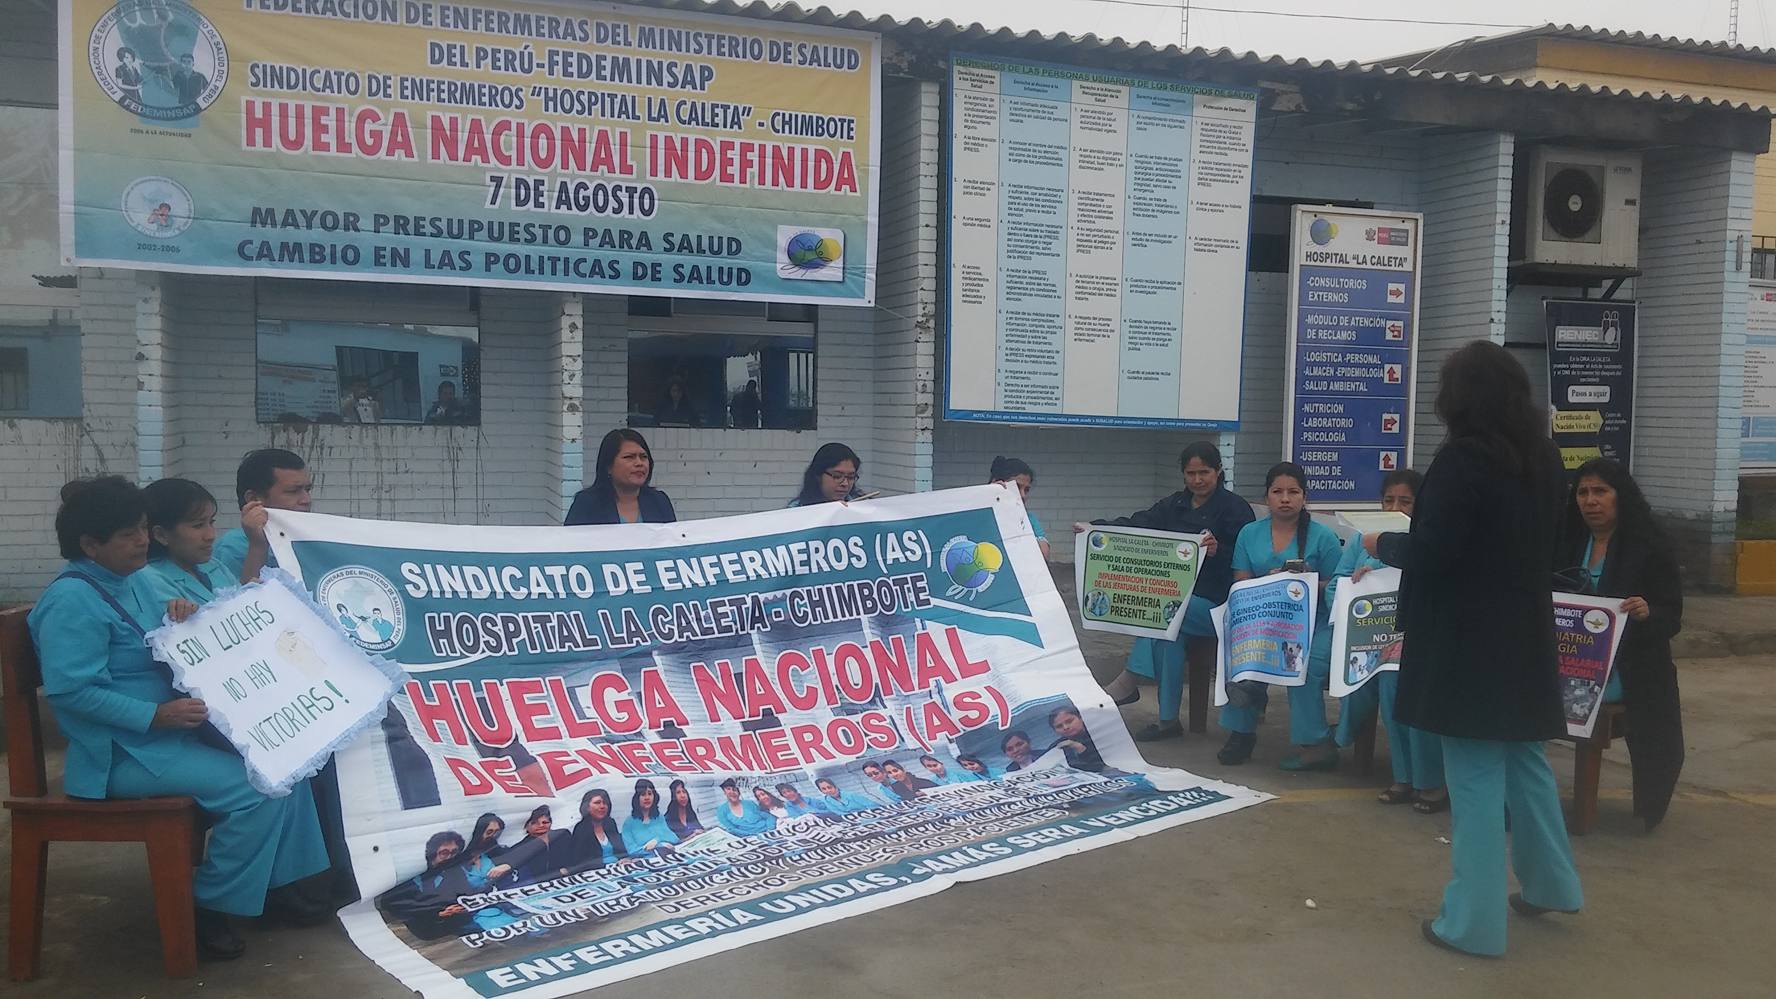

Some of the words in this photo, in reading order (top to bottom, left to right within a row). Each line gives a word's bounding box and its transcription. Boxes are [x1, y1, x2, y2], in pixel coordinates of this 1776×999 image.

[406, 4, 433, 26] DE
[440, 6, 589, 42] ENFERMERAS
[596, 21, 632, 47] DEL
[638, 25, 762, 60] MINISTERIO
[768, 40, 792, 63] DE
[798, 43, 860, 70] SALUD
[430, 41, 469, 68] DEL
[475, 44, 714, 91] PERÚ-FEDEMINSAP
[1008, 64, 1020, 73] DE
[1023, 65, 1040, 75] LAS
[1042, 68, 1090, 81] PERSONAS
[1092, 75, 1135, 87] USUARIAS
[1138, 80, 1149, 89] DE
[1151, 81, 1168, 91] LOS
[1169, 82, 1213, 96] SERVICIOS
[250, 63, 360, 96] SINDICATO
[367, 73, 392, 99] DE
[400, 77, 524, 110] ENFERMEROS
[647, 96, 669, 123] LA
[771, 111, 855, 140] CHIMBOTE
[245, 99, 415, 159] HUELGA
[430, 114, 634, 176] NACIONAL
[649, 133, 858, 194] INDEFINIDA
[489, 175, 504, 206] 7
[514, 176, 545, 209] DE
[555, 180, 656, 217] AGOSTO
[250, 206, 361, 233] MAYOR
[373, 213, 571, 246] PRESUPUESTO
[583, 227, 653, 251] PARA
[663, 232, 742, 257] SALUD
[237, 239, 361, 266] CAMBIO
[374, 246, 411, 269] EN
[424, 248, 473, 272] LAS
[484, 252, 620, 280] POLITICAS
[632, 262, 663, 283] DE
[672, 263, 752, 287] SALUD
[1305, 251, 1350, 265] HOSPITAL
[1306, 276, 1367, 290] -CONSULTORIOS
[1308, 291, 1349, 303] EXTERNOS
[1306, 328, 1317, 339] DE
[1318, 329, 1357, 341] RECLAMOS
[1339, 315, 1349, 326] DE
[1350, 316, 1386, 328] ATENCIÓN
[1558, 329, 1599, 340] RENIEC
[1329, 381, 1368, 392] AMBIENTAL
[1306, 479, 1355, 490] APACITACIÓN
[1332, 466, 1342, 476] DE
[400, 560, 595, 600] SINDICATO
[601, 560, 652, 597] DE
[656, 540, 868, 592] ENFERMEROS
[875, 529, 932, 574] (AS)
[1090, 552, 1113, 562] SERVICIO
[1123, 557, 1163, 569] CONSULTORIOS
[1163, 561, 1191, 572] EXTERNOS
[1111, 564, 1124, 572] SALA
[1126, 565, 1133, 573] DE
[1133, 566, 1171, 577] OPERACIONES
[426, 611, 600, 656] HOSPITAL
[600, 607, 649, 650] LA
[649, 593, 773, 644] CALETA
[785, 573, 932, 626] CHIMBOTE
[1112, 593, 1161, 609] ENFERMERIA
[1257, 610, 1294, 621] CONJUNTO
[209, 600, 276, 651] LUCHAS
[1372, 632, 1388, 642] NO
[222, 676, 248, 703] NO
[246, 659, 278, 690] HAY
[404, 667, 688, 750] HUELGA
[692, 626, 991, 723] NACIONAL
[248, 679, 350, 752] VICTORIAS!
[443, 755, 535, 797] DE
[537, 711, 898, 792] ENFERMEROS
[903, 685, 1012, 753] (AS)
[458, 861, 641, 911] ENFERMERÍA
[552, 888, 595, 905] DE
[600, 879, 637, 898] LA
[657, 872, 801, 915] DERECHOS
[800, 861, 842, 881] DE
[841, 834, 961, 873] NUESROS
[460, 917, 533, 949] POR
[534, 907, 589, 929] UN
[769, 856, 788, 872] Y
[486, 906, 765, 989] ENFERMERÍA
[759, 870, 912, 914] UNIDAS,
[912, 841, 1013, 876] JAMÁS
[1006, 823, 1091, 849] SERA
